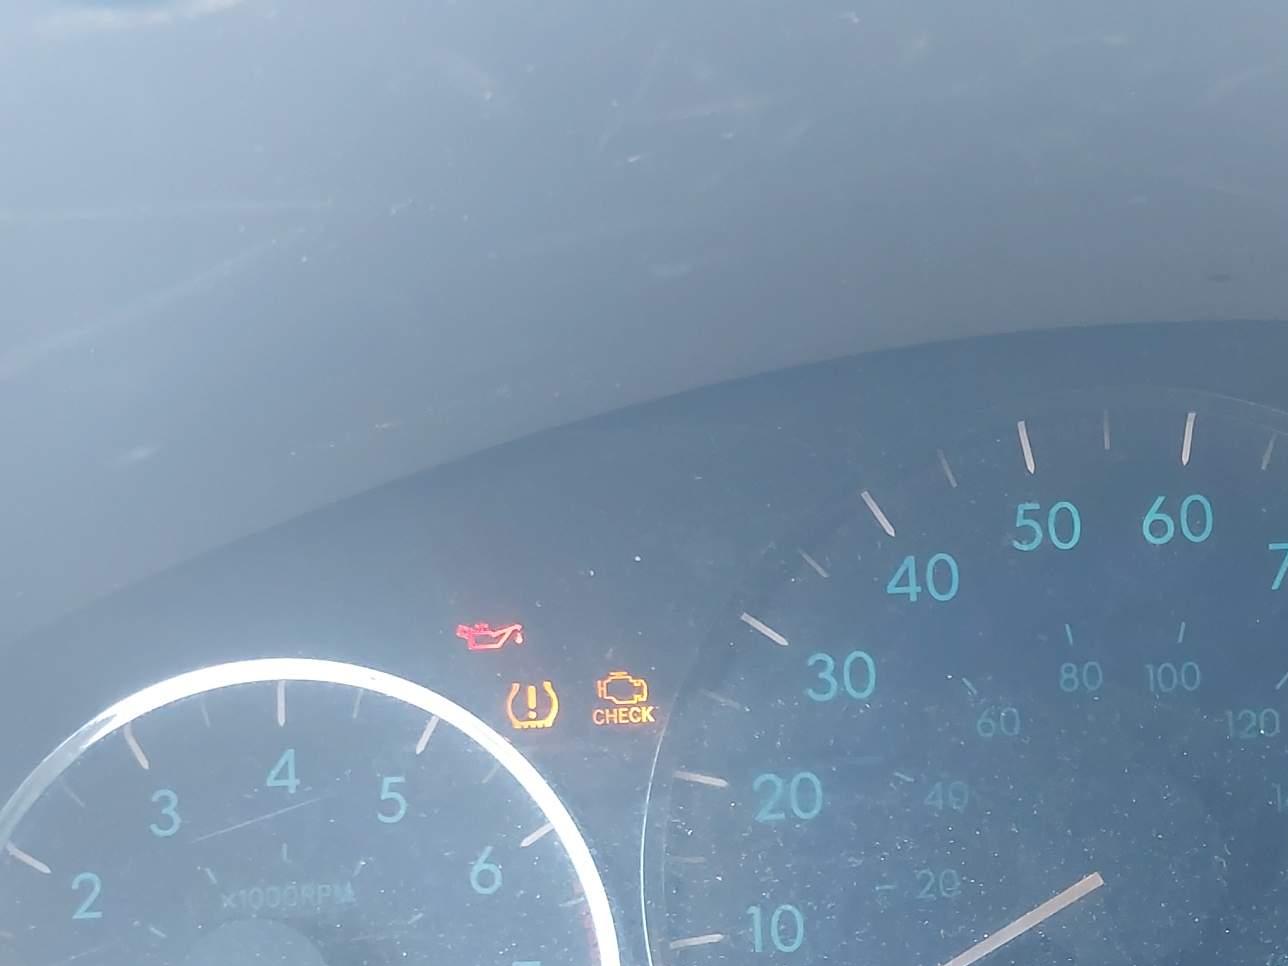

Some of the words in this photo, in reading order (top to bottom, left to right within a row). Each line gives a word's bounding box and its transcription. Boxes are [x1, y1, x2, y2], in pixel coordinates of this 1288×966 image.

[1012, 500, 1082, 552] 50
[1142, 494, 1214, 545] 60
[886, 552, 960, 602] 40
[805, 650, 877, 702] 30
[1058, 661, 1103, 693] 80
[1144, 660, 1201, 694] 100
[592, 706, 655, 726] CHECK
[975, 706, 1021, 738] 60
[1224, 707, 1280, 739] 120
[265, 748, 301, 794] 4
[148, 788, 182, 838] 3
[375, 775, 408, 824] 5
[752, 770, 824, 823] 20
[923, 780, 969, 813] 40
[468, 846, 501, 895] 6
[915, 867, 961, 902] 20
[72, 872, 103, 919] 2
[747, 904, 805, 954] 10
